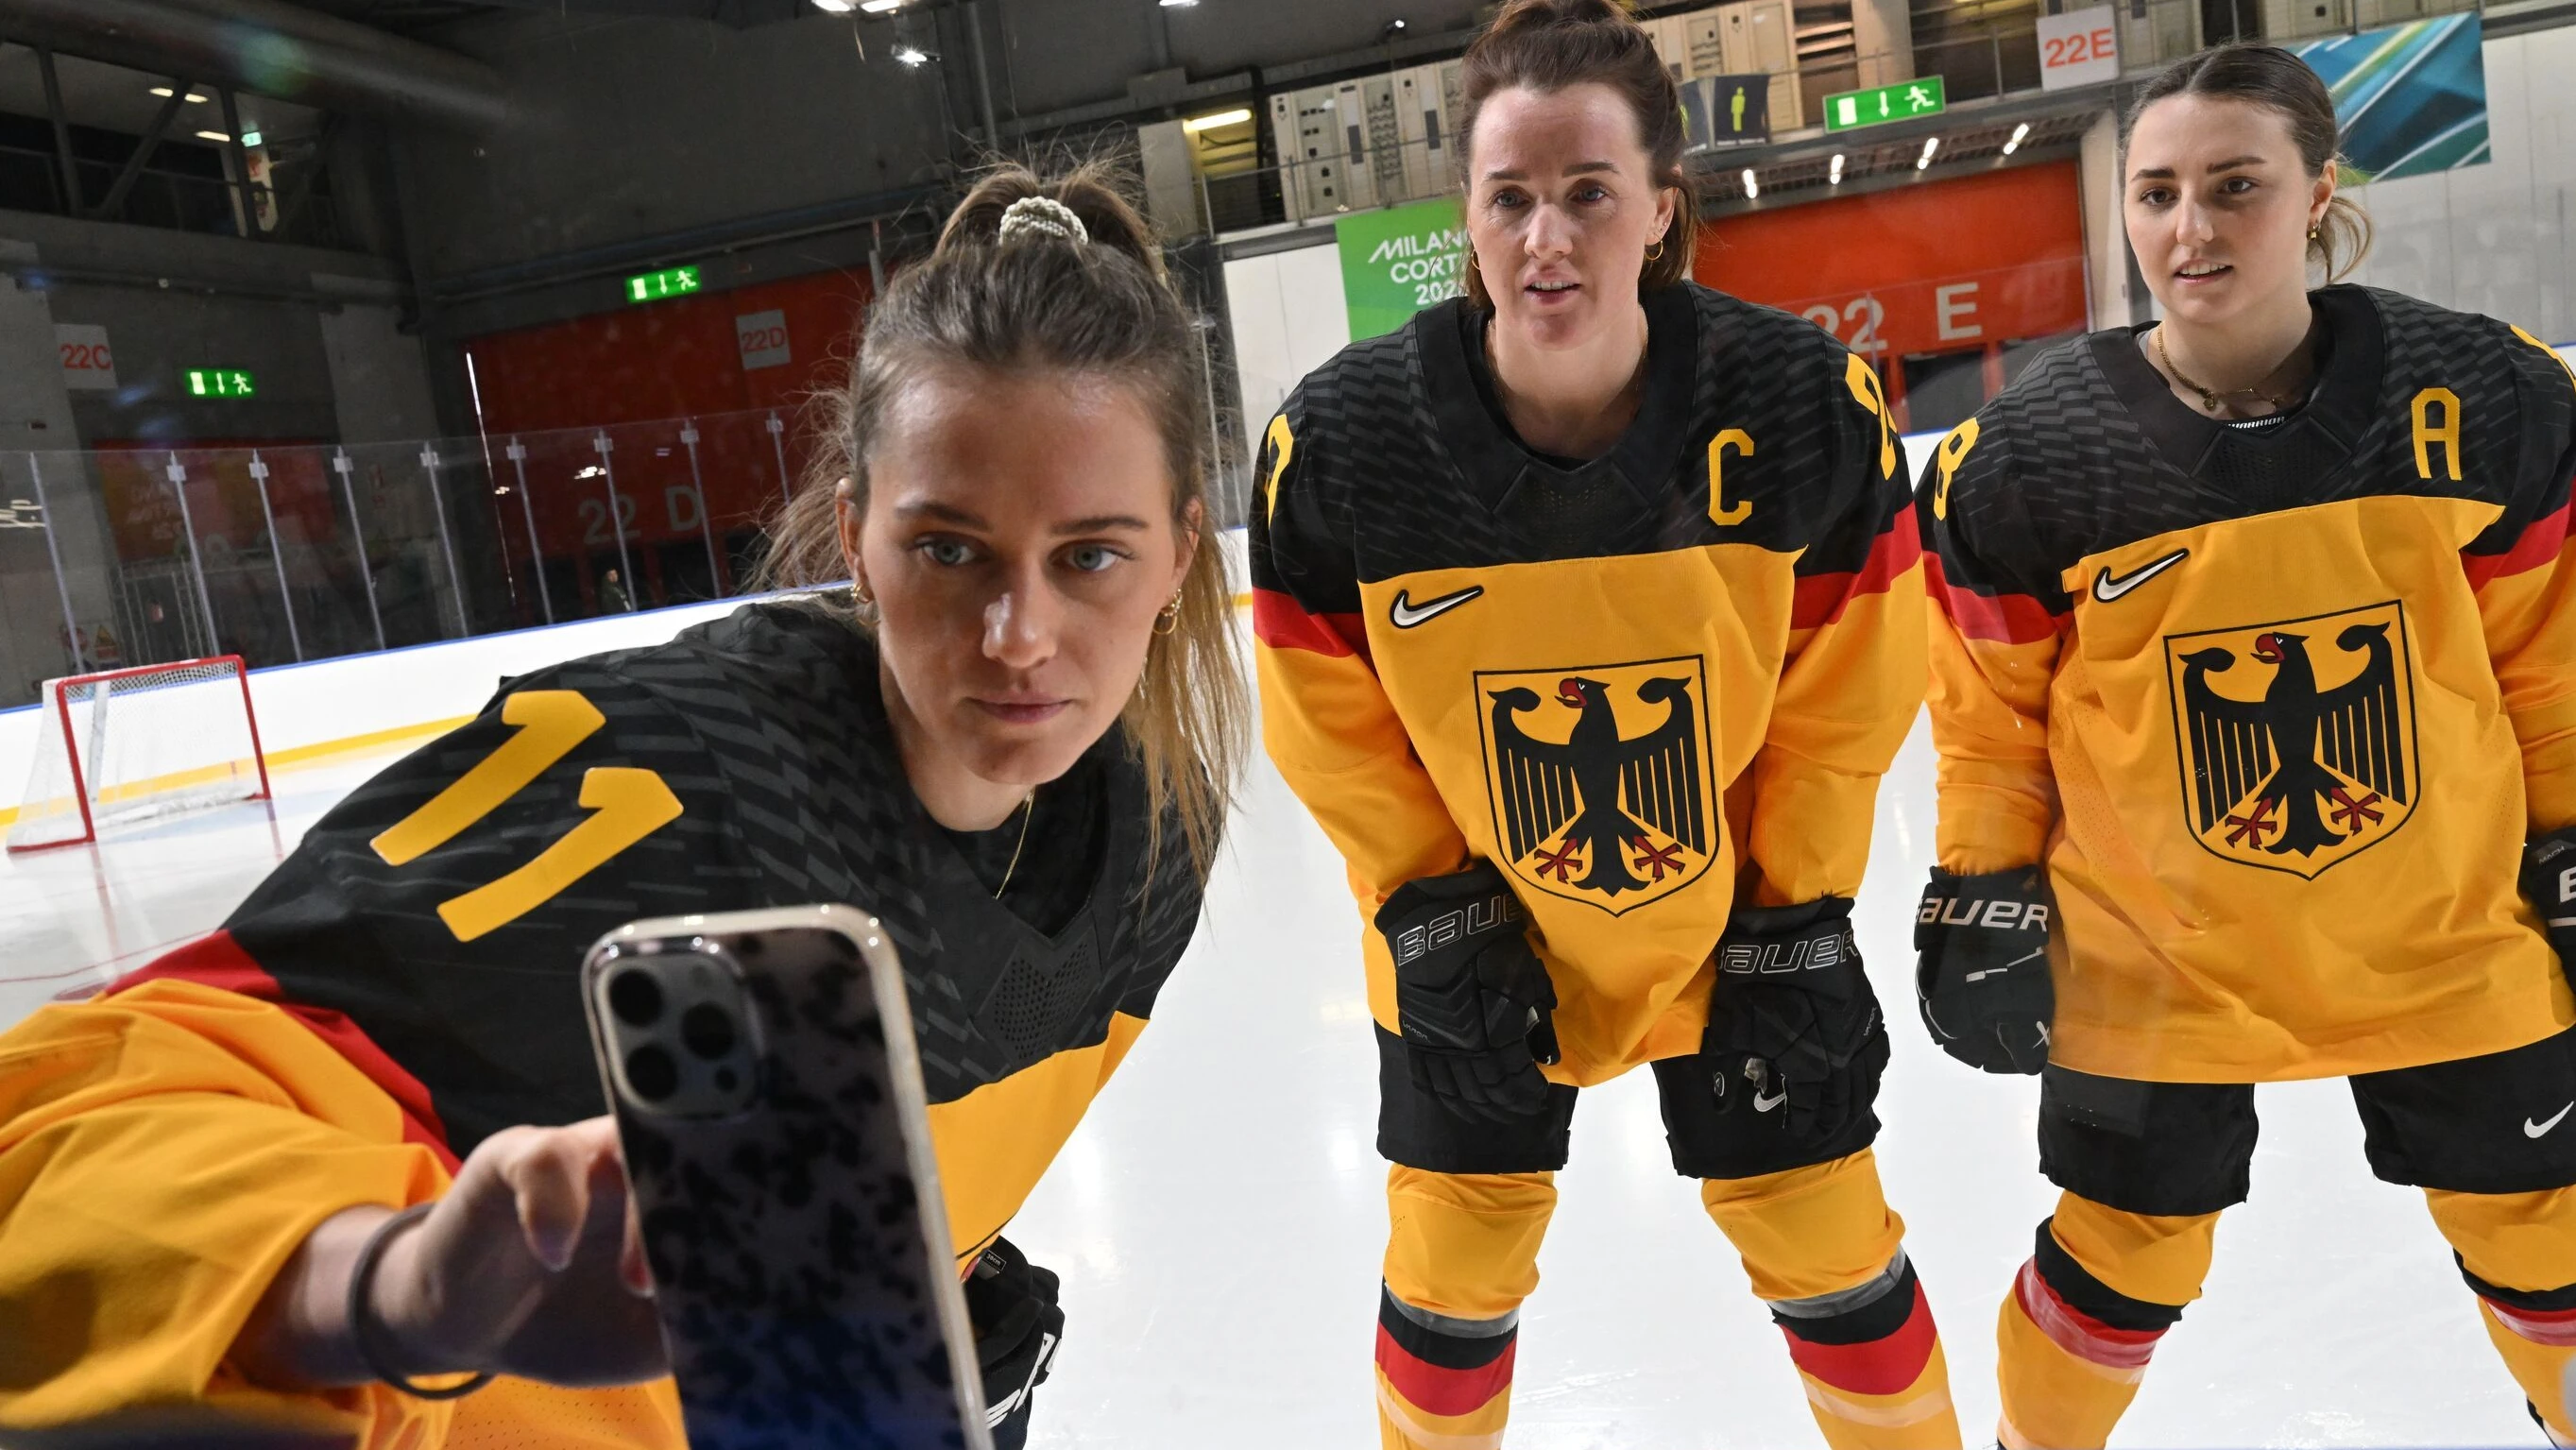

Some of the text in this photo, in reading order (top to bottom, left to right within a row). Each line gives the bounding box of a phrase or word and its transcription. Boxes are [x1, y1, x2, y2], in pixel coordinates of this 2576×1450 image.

[2044, 28, 2116, 68] 22E
[1368, 229, 1468, 264] MILAN
[1390, 252, 1466, 283] CORT
[1414, 280, 1467, 305] 202
[1801, 282, 1983, 354] 22 E
[60, 343, 112, 370] 22C
[742, 327, 786, 354] 22D
[2411, 387, 2462, 481] A
[1708, 428, 1754, 526] C
[578, 485, 703, 544] 22 D
[369, 690, 684, 943] 11
[1915, 897, 2048, 933] AUER
[1716, 928, 1858, 974] AUER
